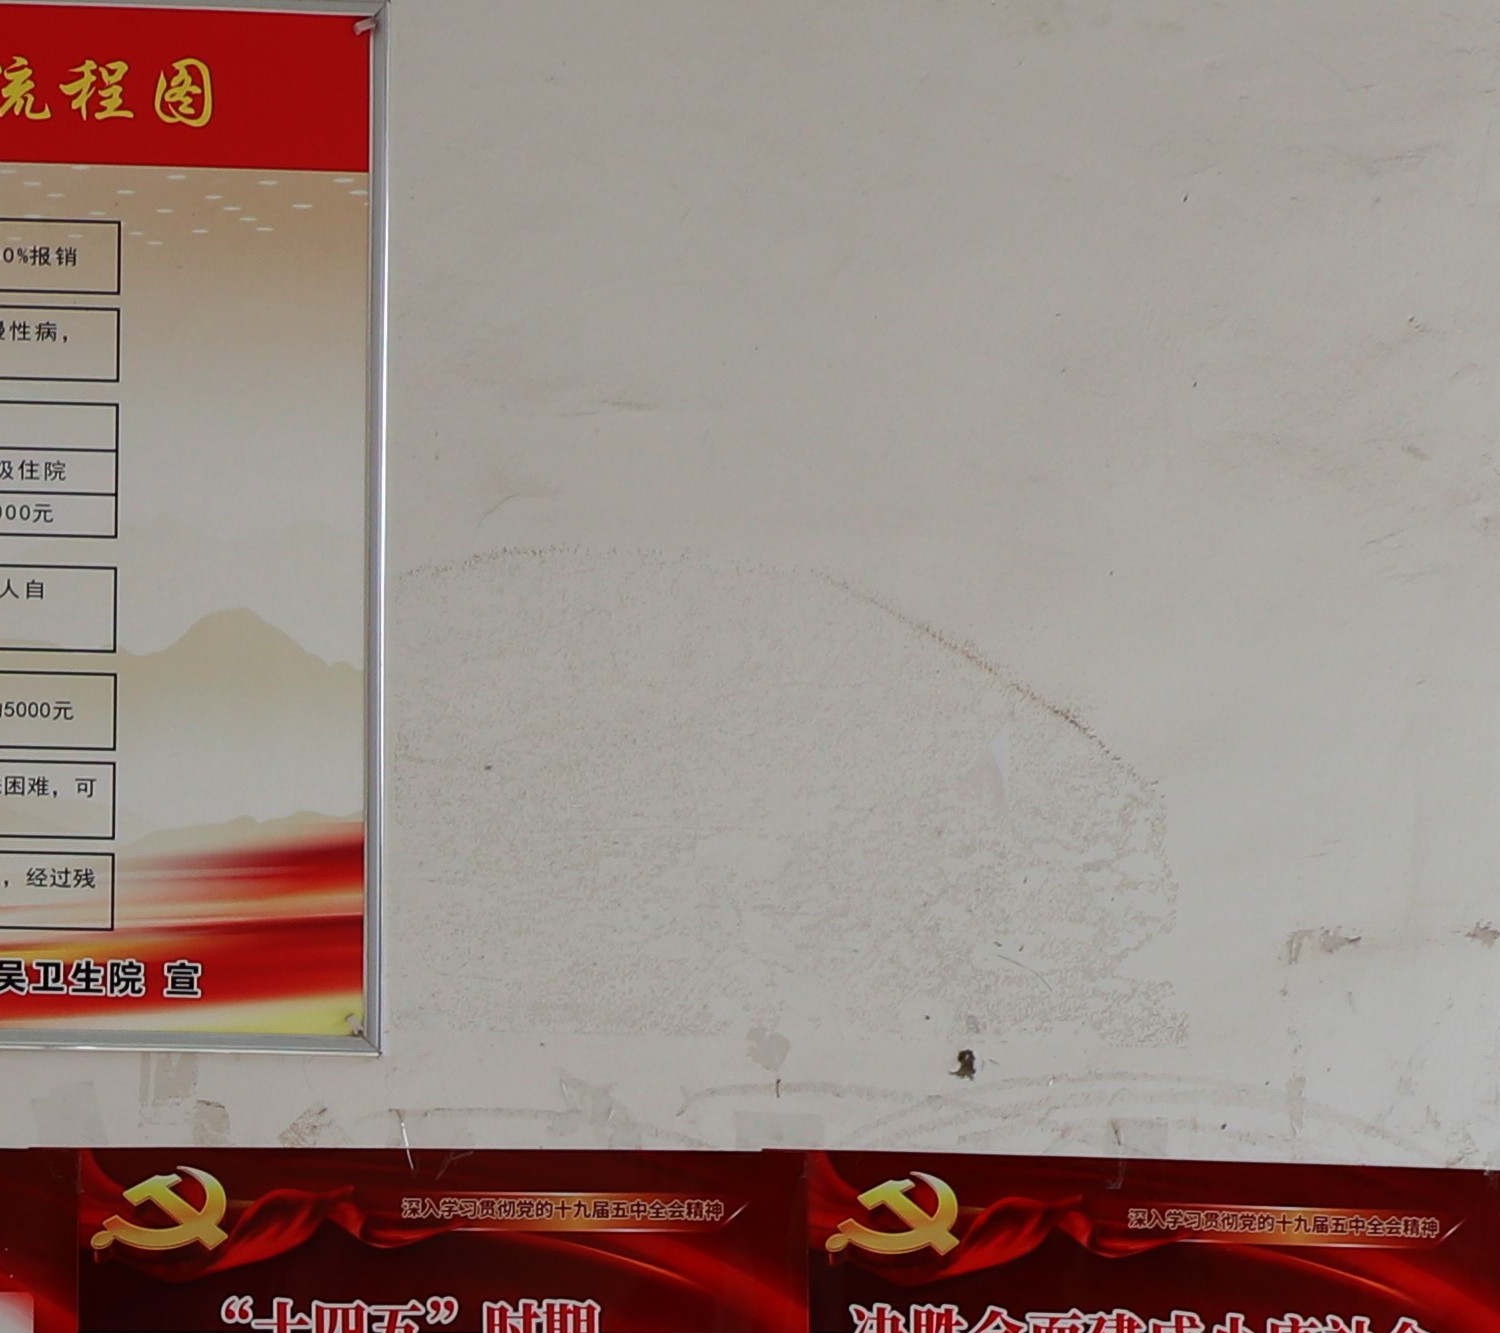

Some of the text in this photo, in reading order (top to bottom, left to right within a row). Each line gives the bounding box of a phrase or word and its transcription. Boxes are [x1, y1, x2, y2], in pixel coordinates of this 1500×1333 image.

[167, 960, 203, 997] 宣
[401, 1196, 724, 1222] 深入学习贯彻党的十九届五中全会精神
[1128, 1207, 1439, 1239] 深入学习贯彻党的十九届五中全会精神
